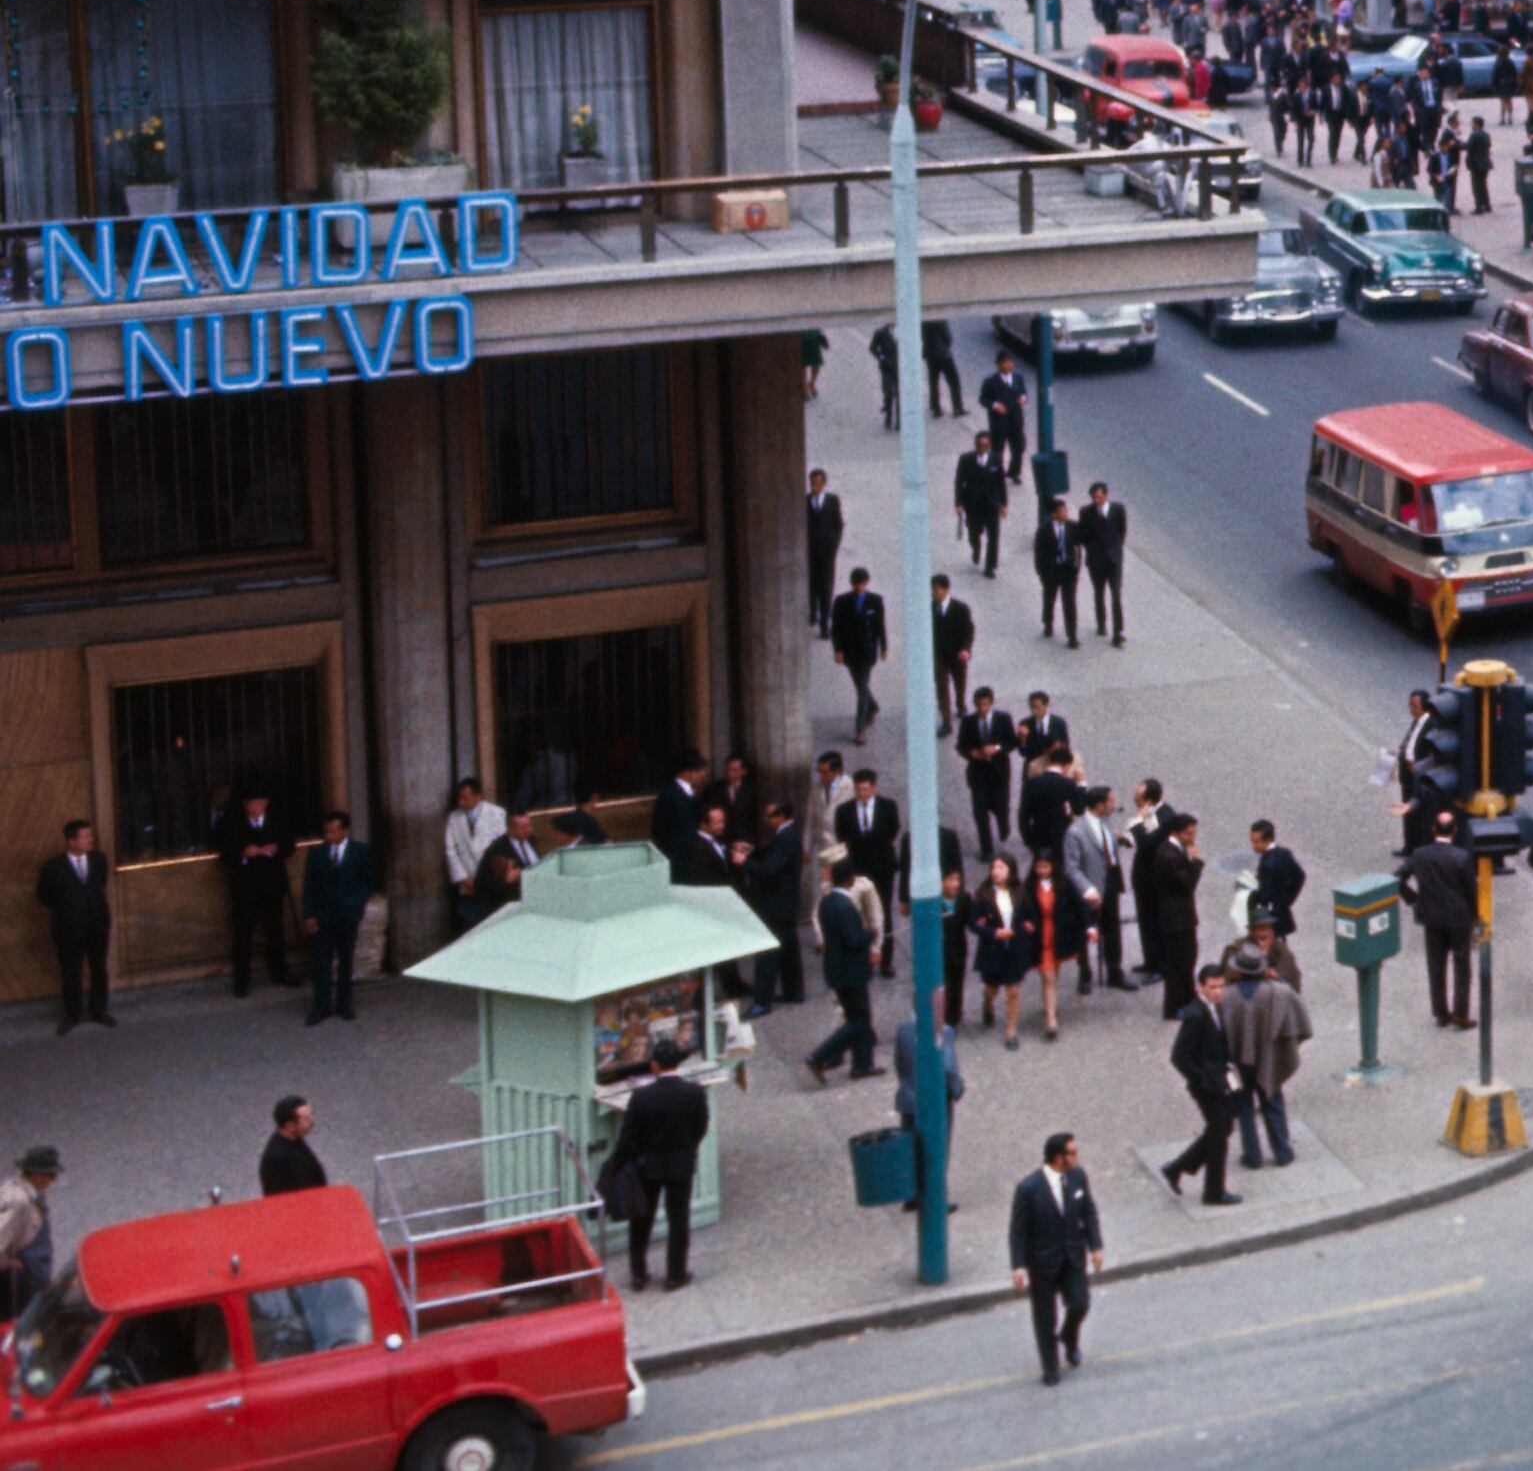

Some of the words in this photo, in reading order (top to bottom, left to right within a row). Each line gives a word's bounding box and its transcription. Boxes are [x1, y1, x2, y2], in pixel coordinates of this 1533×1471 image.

[42, 192, 521, 307] NAVIDAD
[6, 326, 71, 412] O
[123, 293, 475, 402] NUEVO
